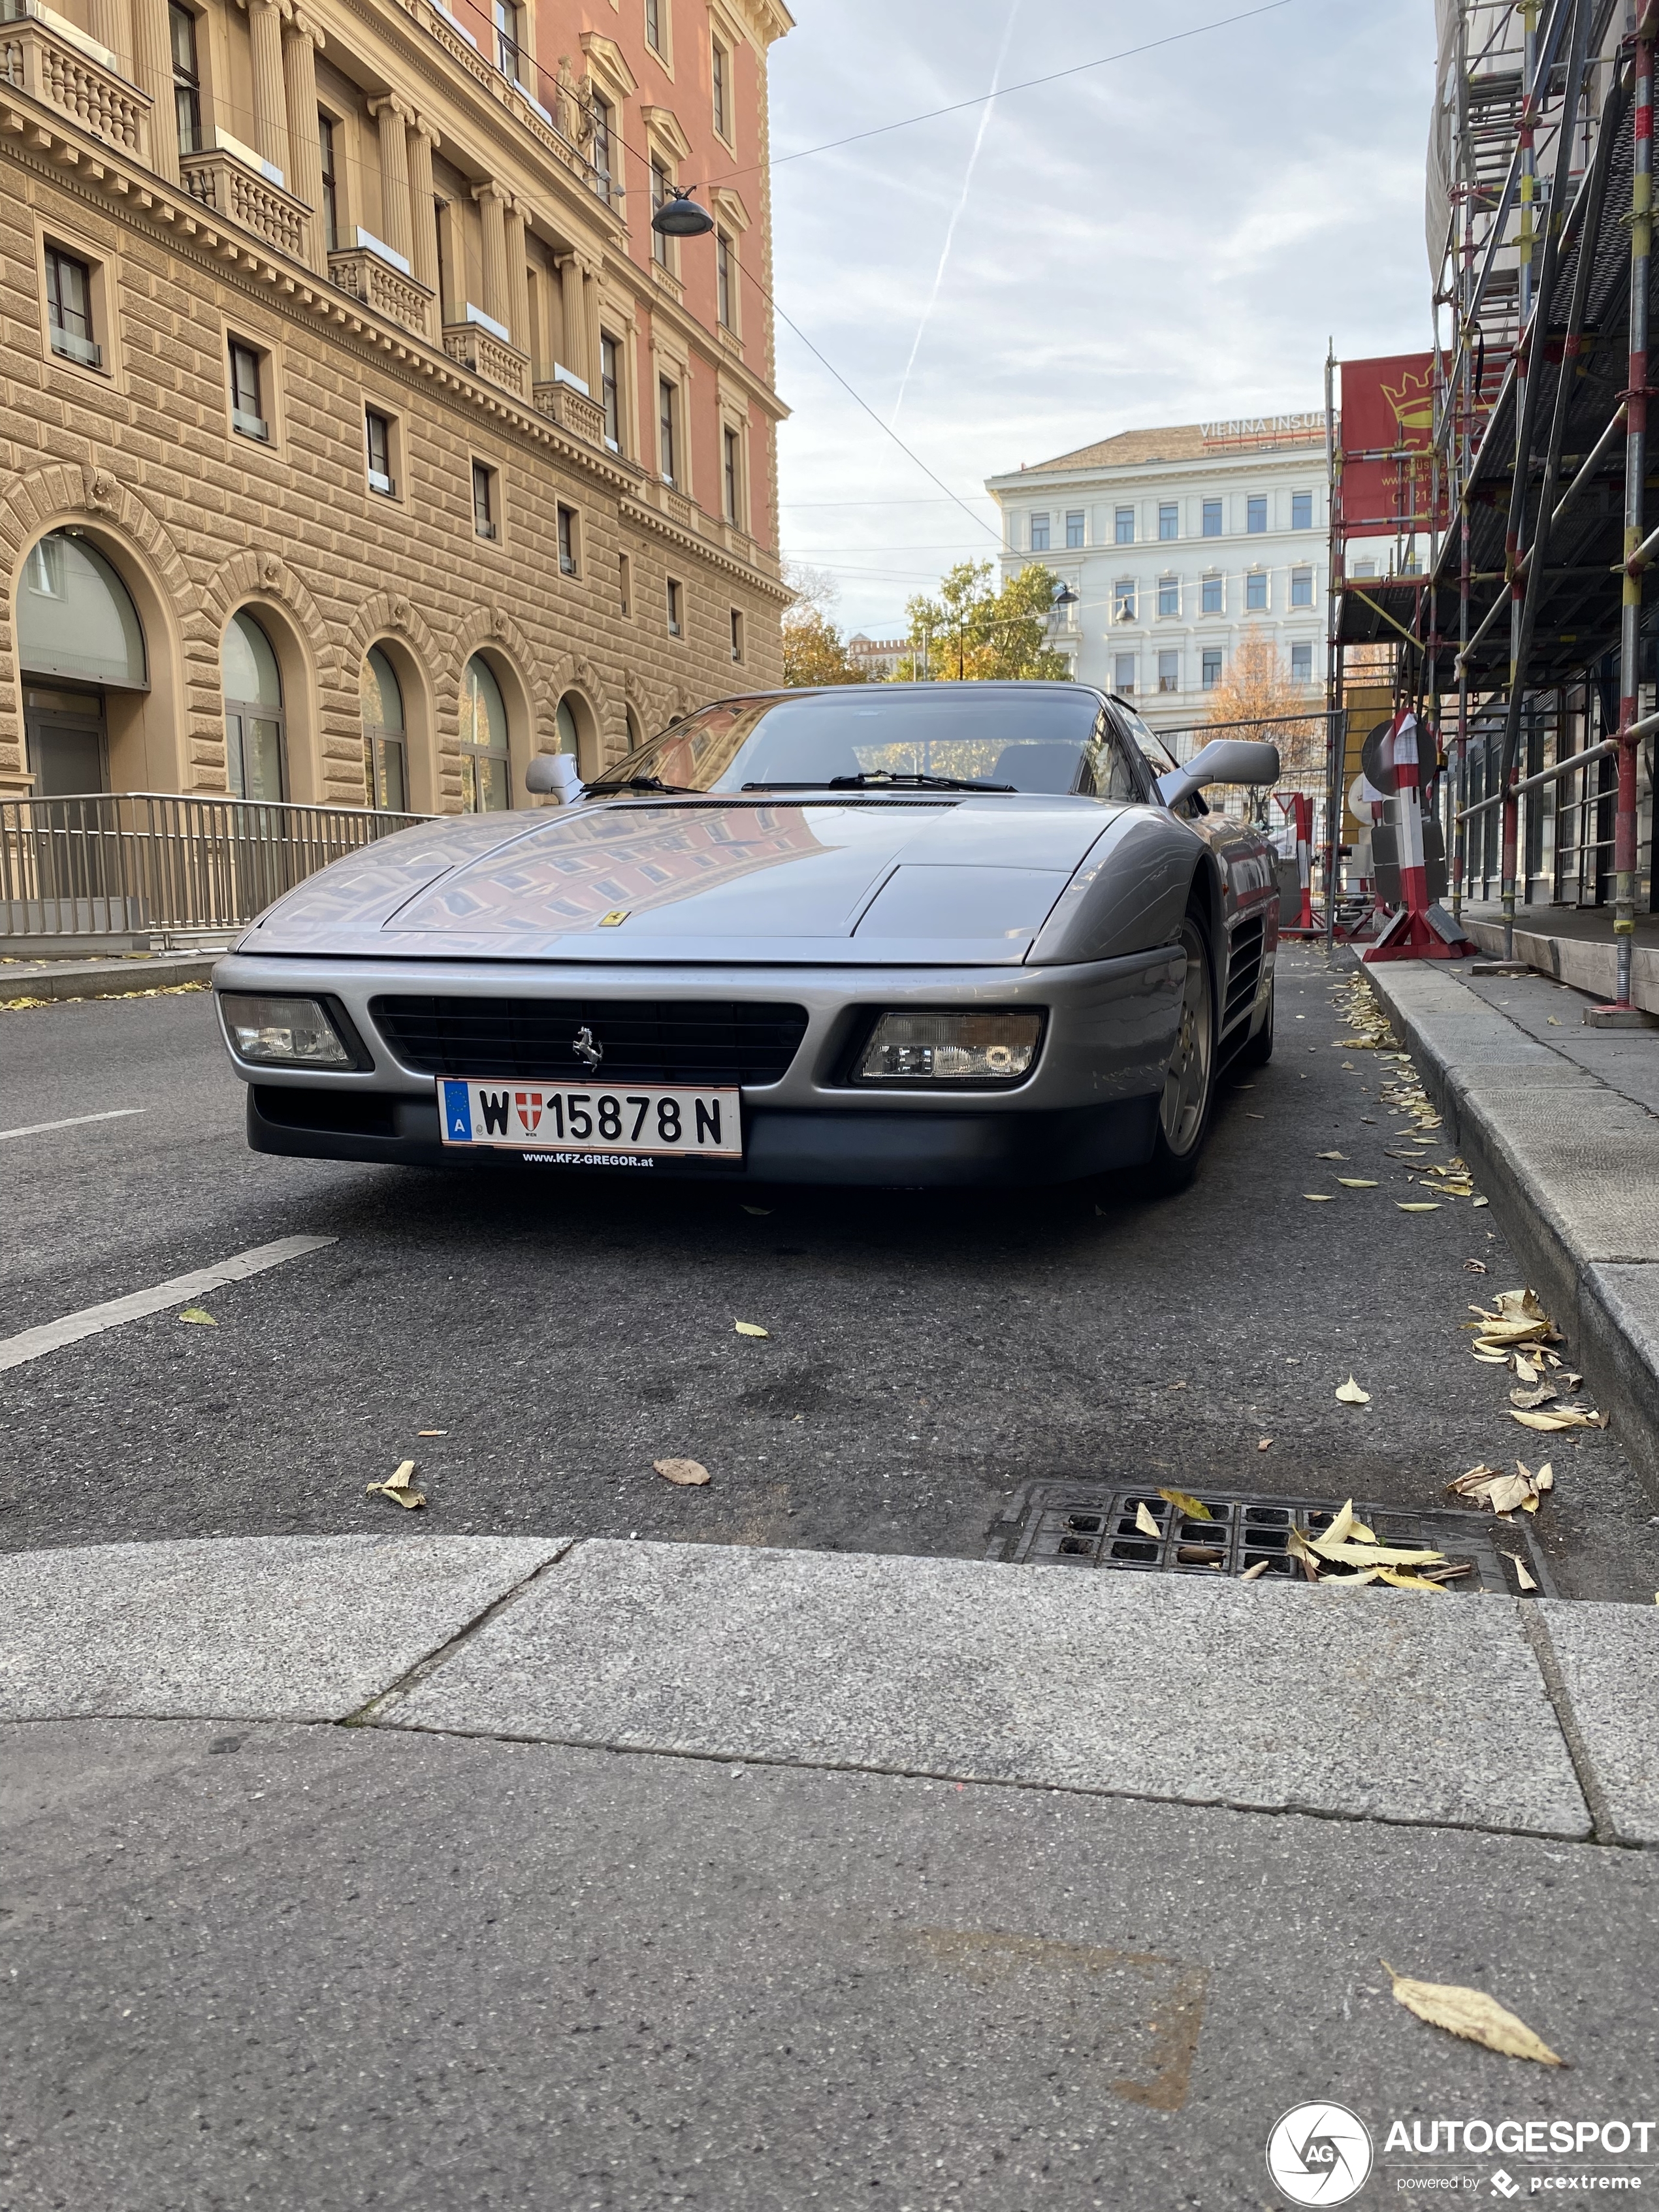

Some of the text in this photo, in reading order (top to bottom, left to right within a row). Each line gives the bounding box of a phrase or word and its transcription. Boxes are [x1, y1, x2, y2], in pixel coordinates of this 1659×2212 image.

[1200, 419, 1266, 437] VIENNA
[479, 1090, 722, 1144] W 15878 N
[454, 1119, 466, 1132] A
[523, 1153, 654, 1167] www.KFZ-GREGOR.at
